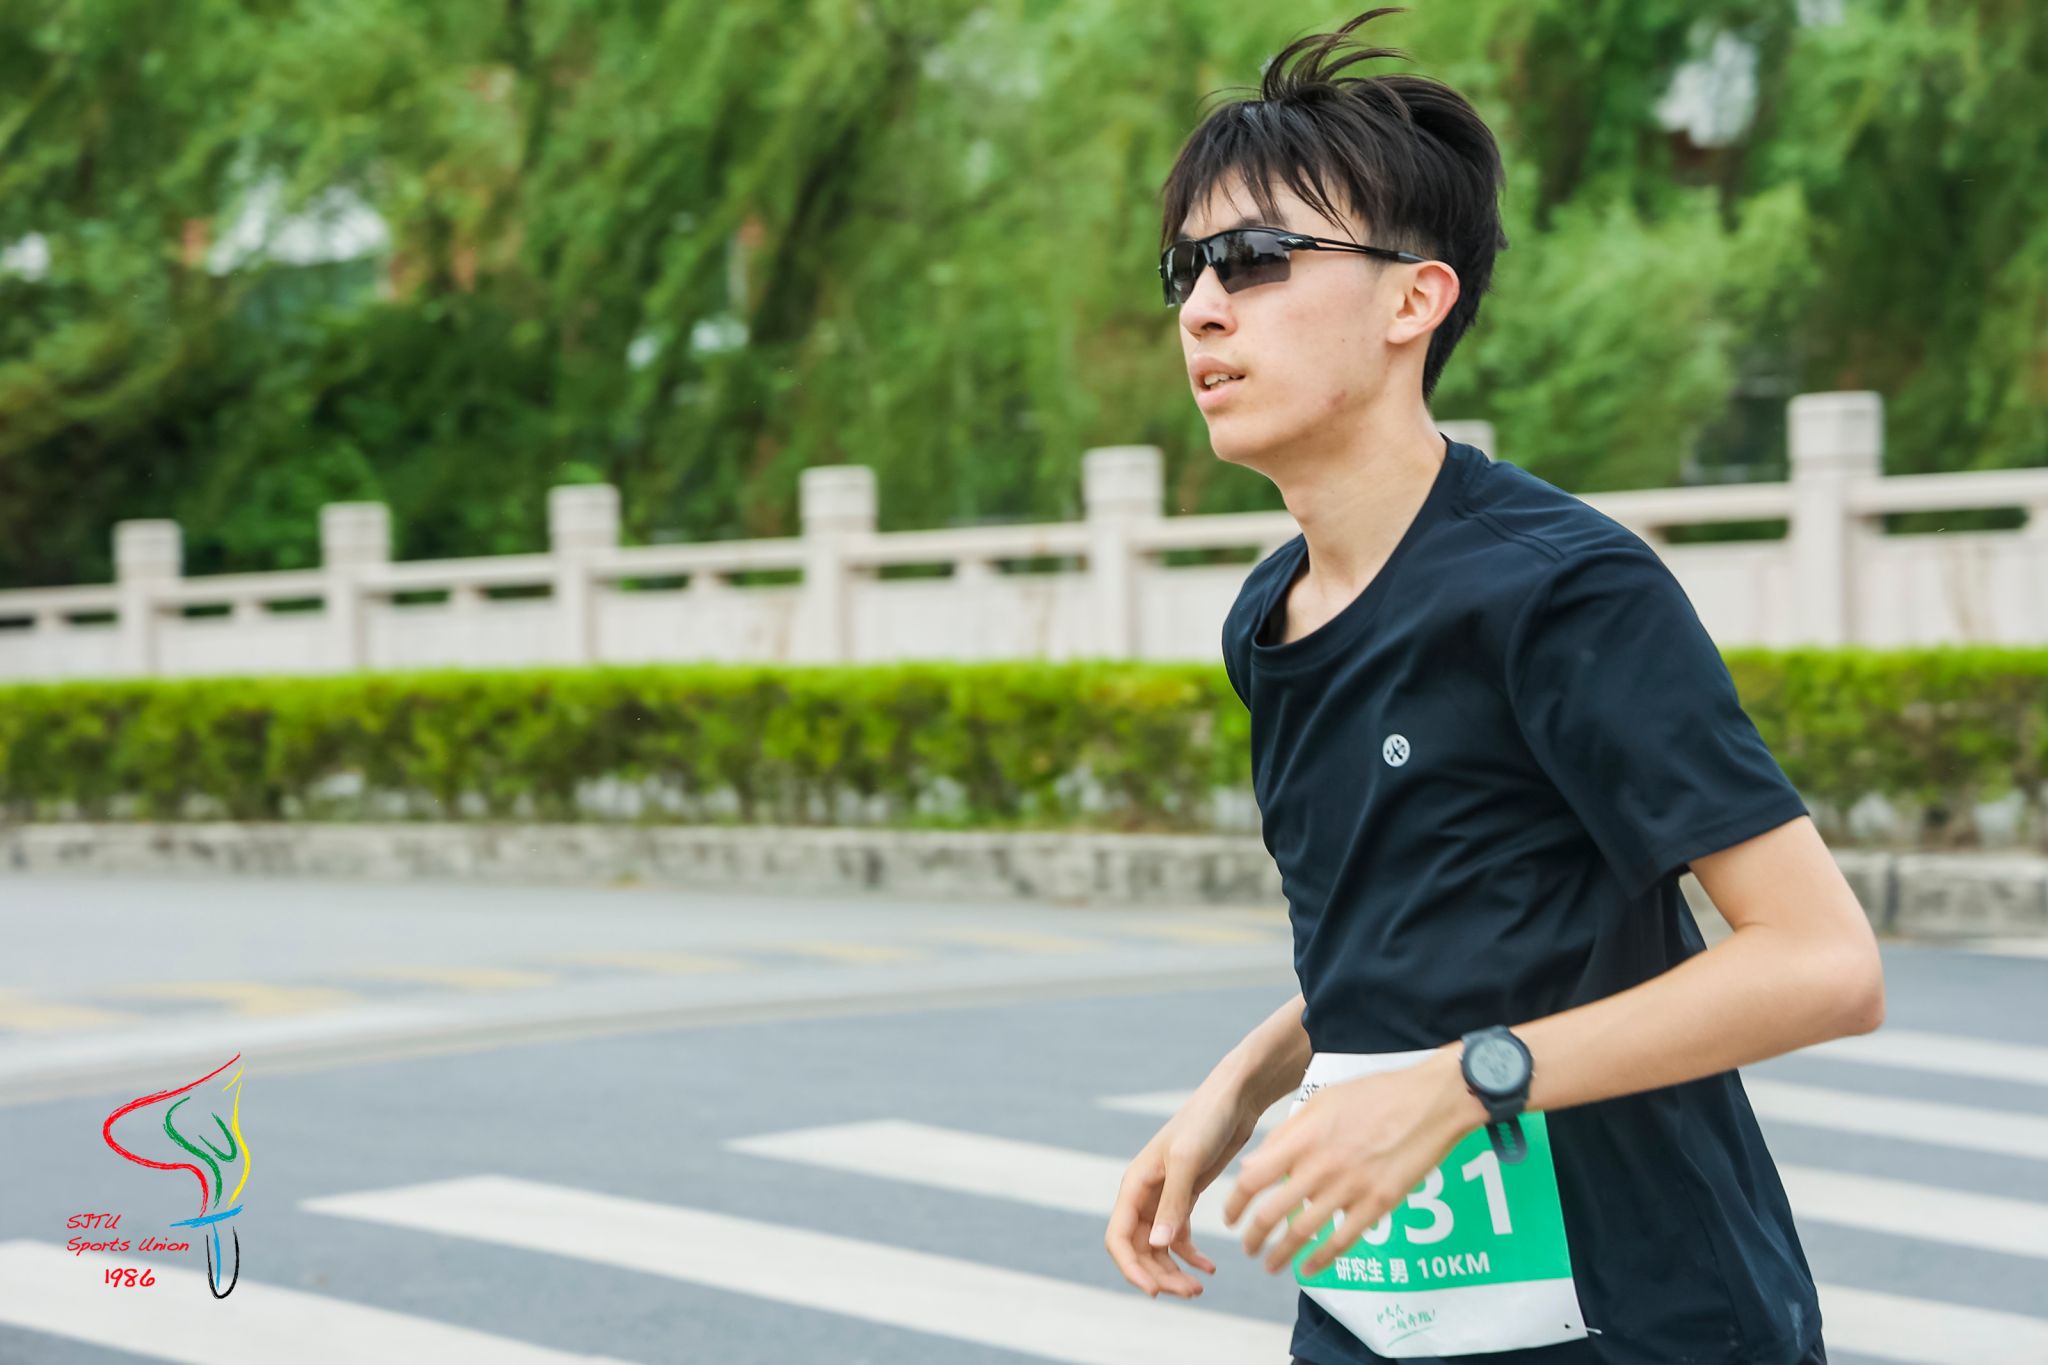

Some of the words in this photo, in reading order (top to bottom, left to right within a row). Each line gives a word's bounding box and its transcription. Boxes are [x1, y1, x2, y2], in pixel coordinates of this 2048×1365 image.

[1334, 1256, 1386, 1284] 研究生
[1389, 1257, 1410, 1285] 男
[1416, 1251, 1491, 1280] 10KM
